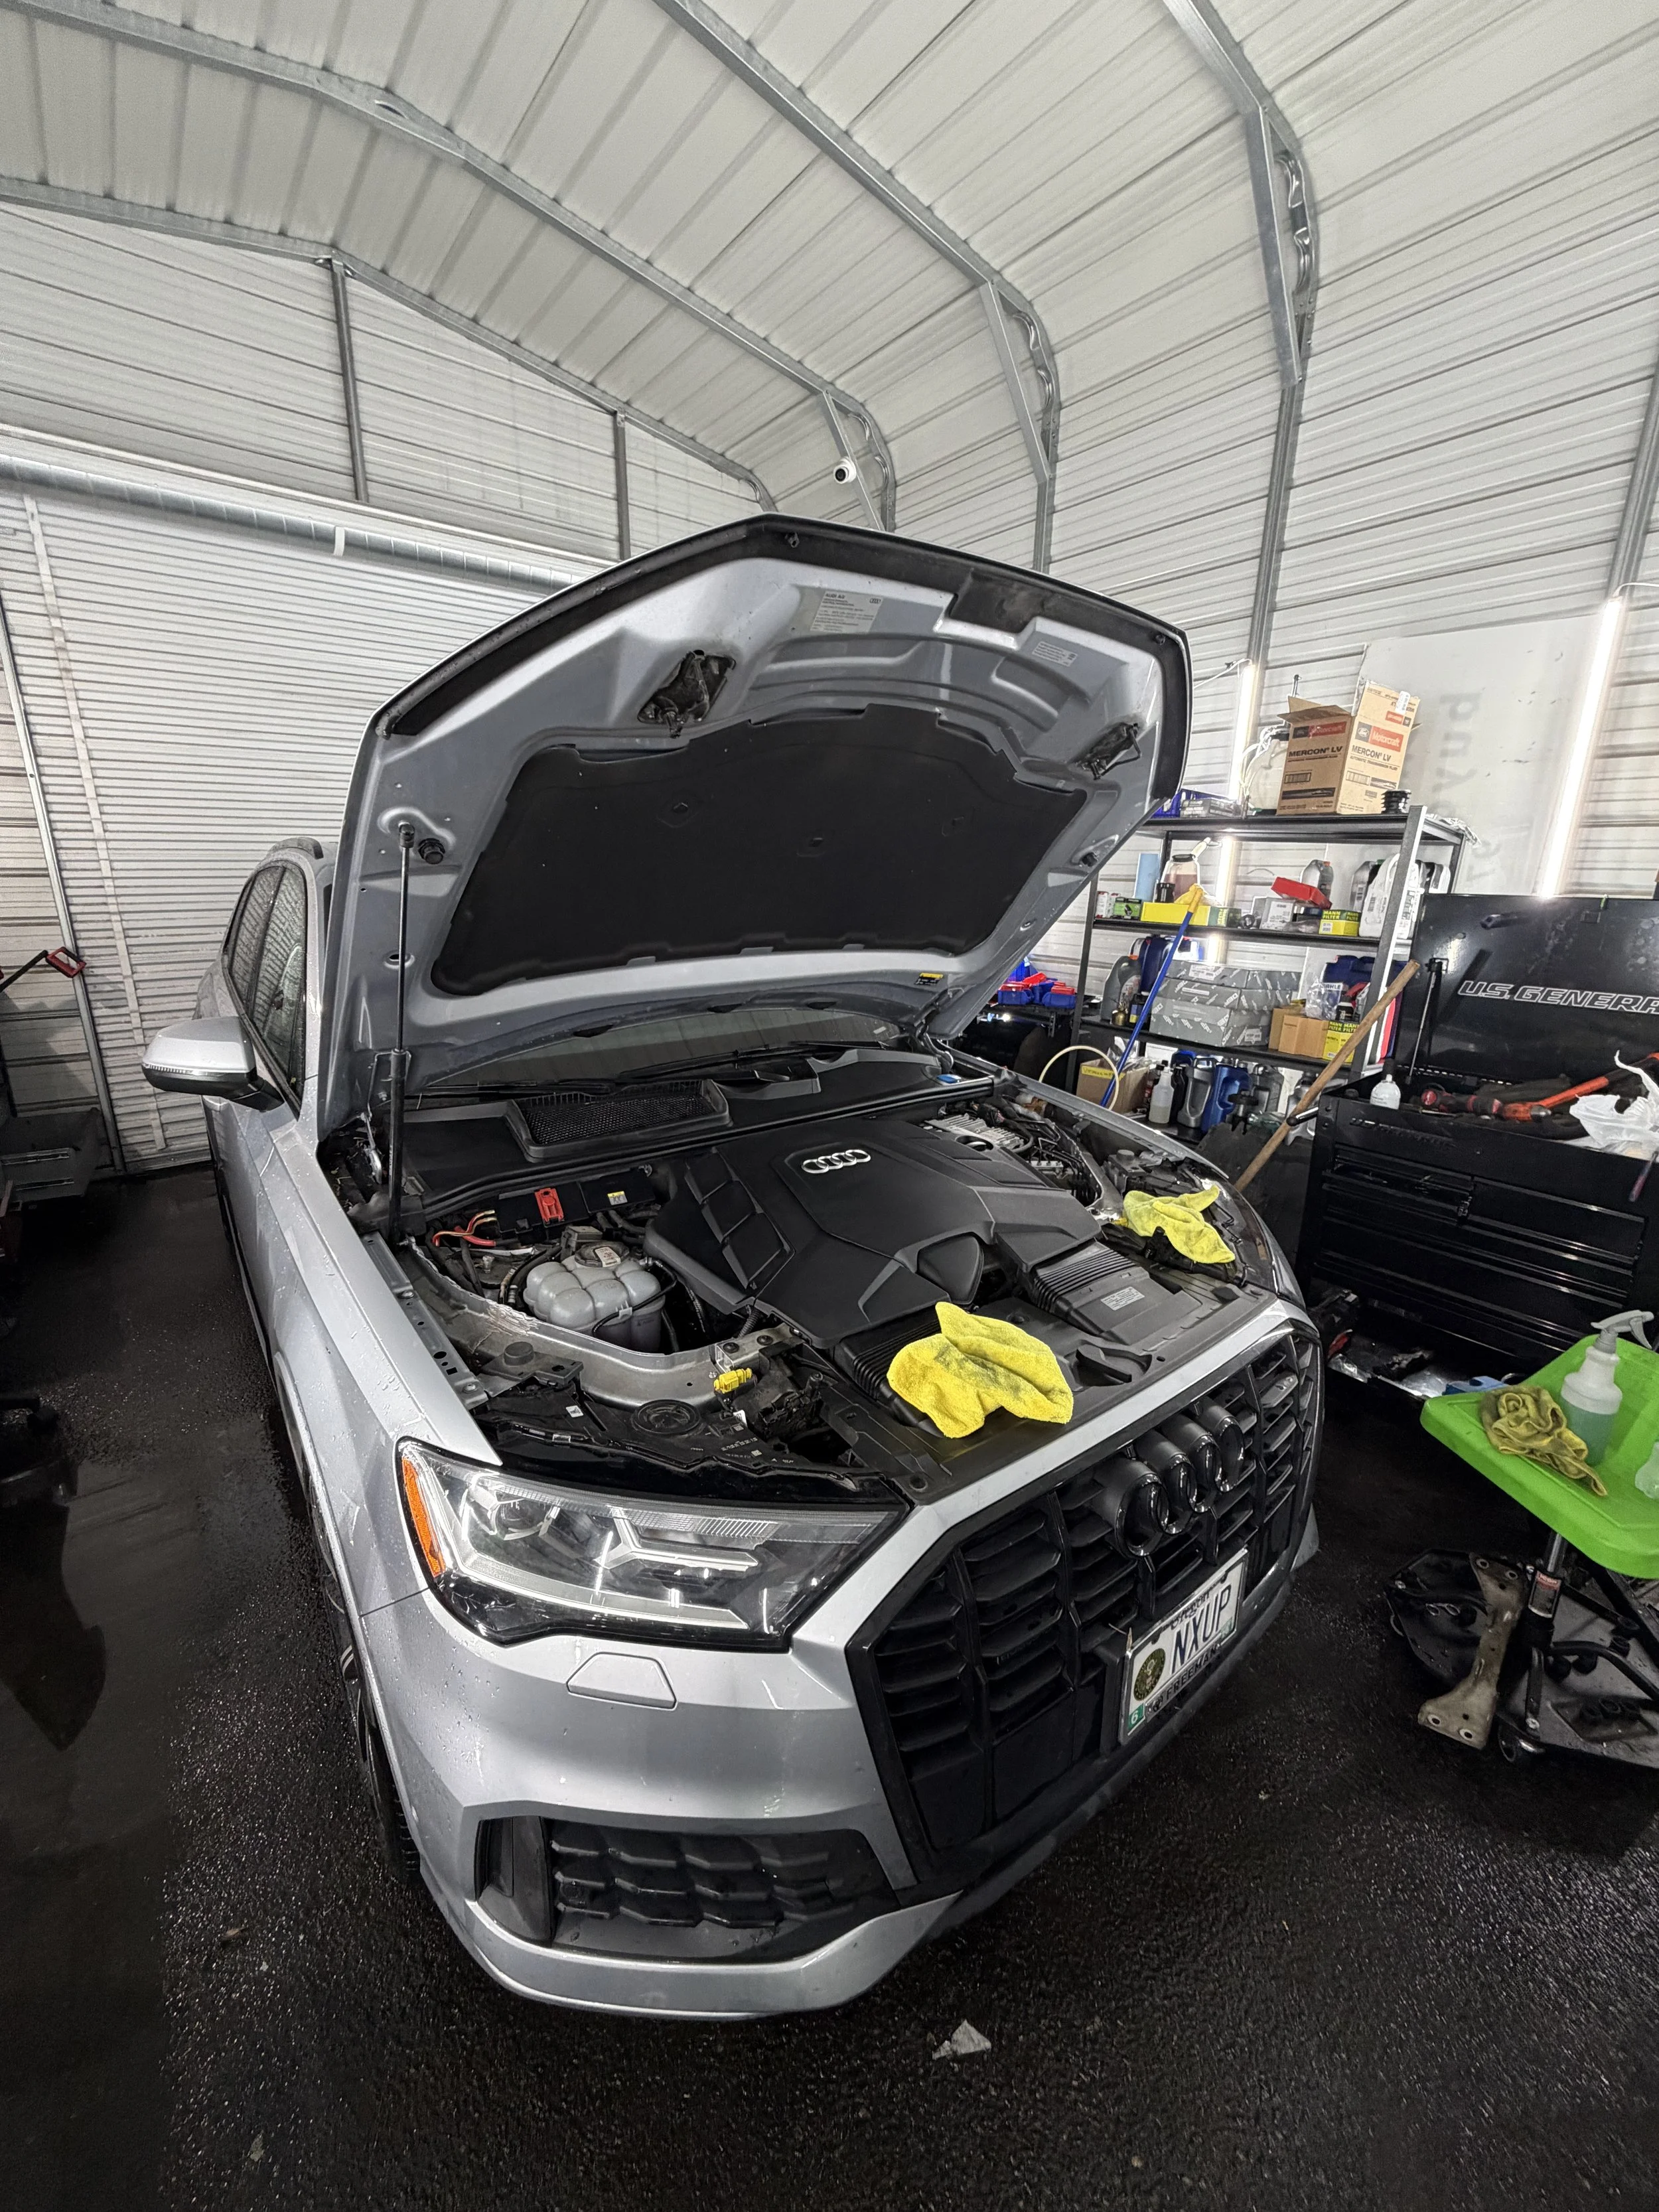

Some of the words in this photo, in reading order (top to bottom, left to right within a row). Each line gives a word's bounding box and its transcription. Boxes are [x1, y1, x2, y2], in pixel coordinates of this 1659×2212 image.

[1372, 729, 1400, 747] Motorcraft
[1288, 748, 1327, 757] MERCON
[1351, 744, 1380, 759] MERCON
[1382, 753, 1392, 762] LV
[1457, 980, 1515, 1000] U.S.
[1172, 1584, 1232, 1675] NXUP
[1166, 1644, 1218, 1700] FREEMAN
[1130, 1709, 1139, 1725] 6
